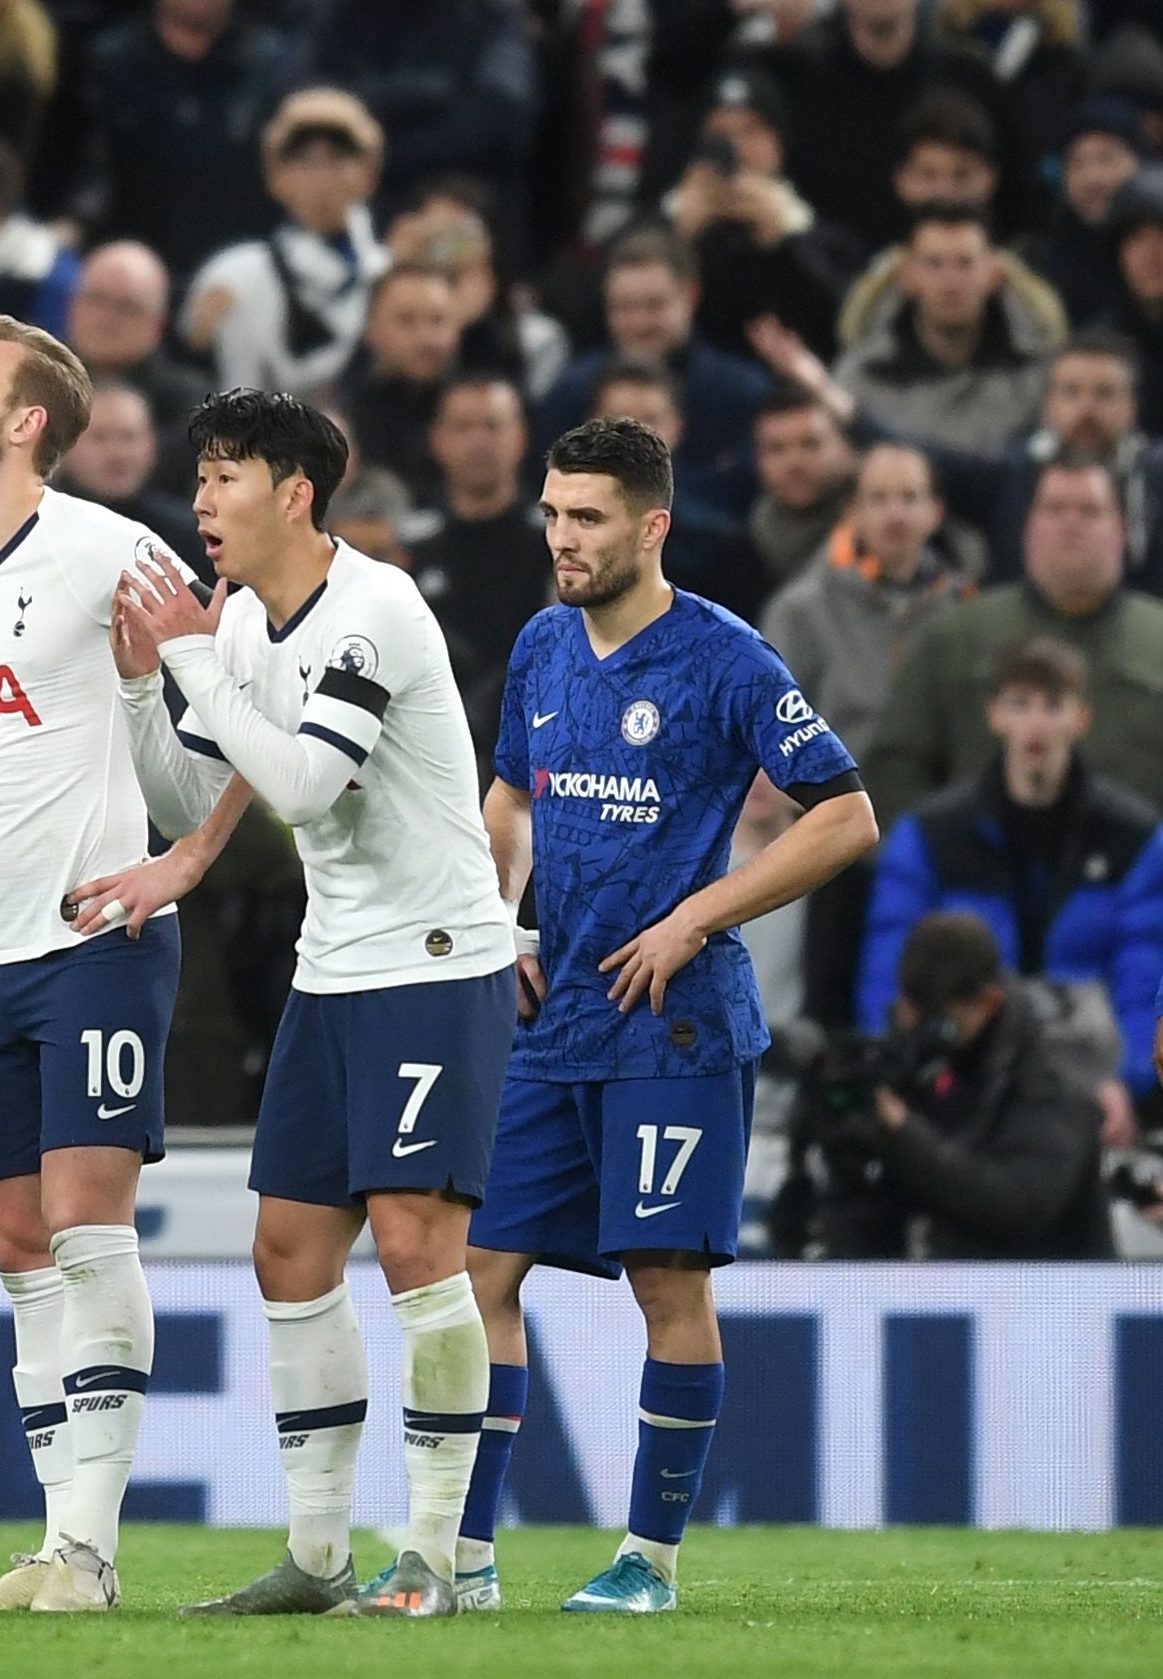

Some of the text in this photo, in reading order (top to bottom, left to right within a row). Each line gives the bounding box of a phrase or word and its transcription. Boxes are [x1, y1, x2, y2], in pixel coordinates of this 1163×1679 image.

[600, 803, 660, 823] TYRES
[80, 1029, 146, 1099] 10
[398, 1062, 443, 1134] 7
[637, 1124, 703, 1195] 17
[72, 1394, 128, 1413] SPURS
[661, 1491, 690, 1503] CFC
